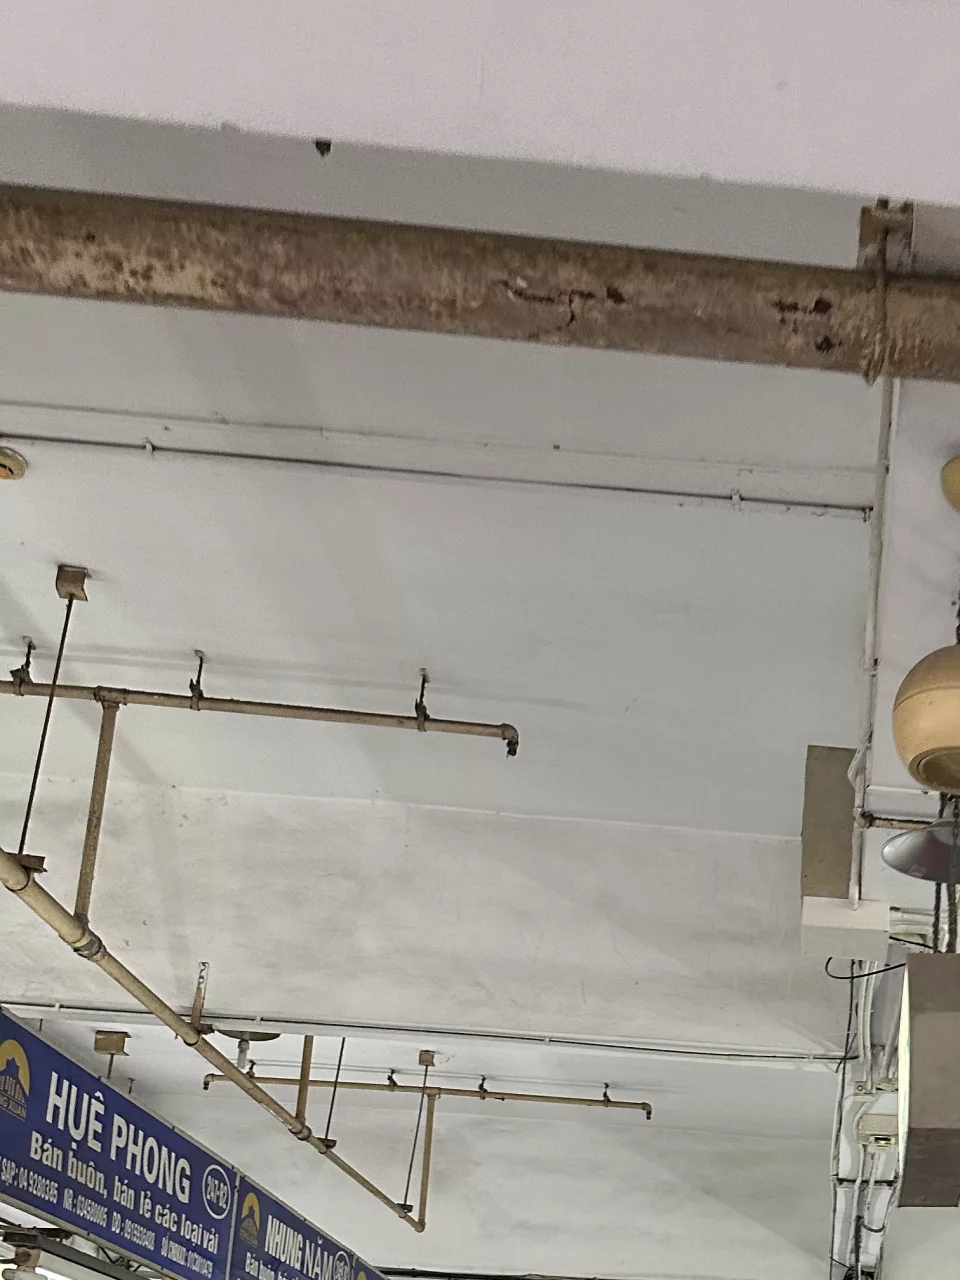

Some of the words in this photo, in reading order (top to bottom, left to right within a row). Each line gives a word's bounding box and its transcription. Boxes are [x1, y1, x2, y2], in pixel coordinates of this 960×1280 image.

[29, 1130, 62, 1171] Bán
[112, 1175, 134, 1209] bán
[154, 1203, 177, 1231] các
[109, 1113, 190, 1203] PHONG
